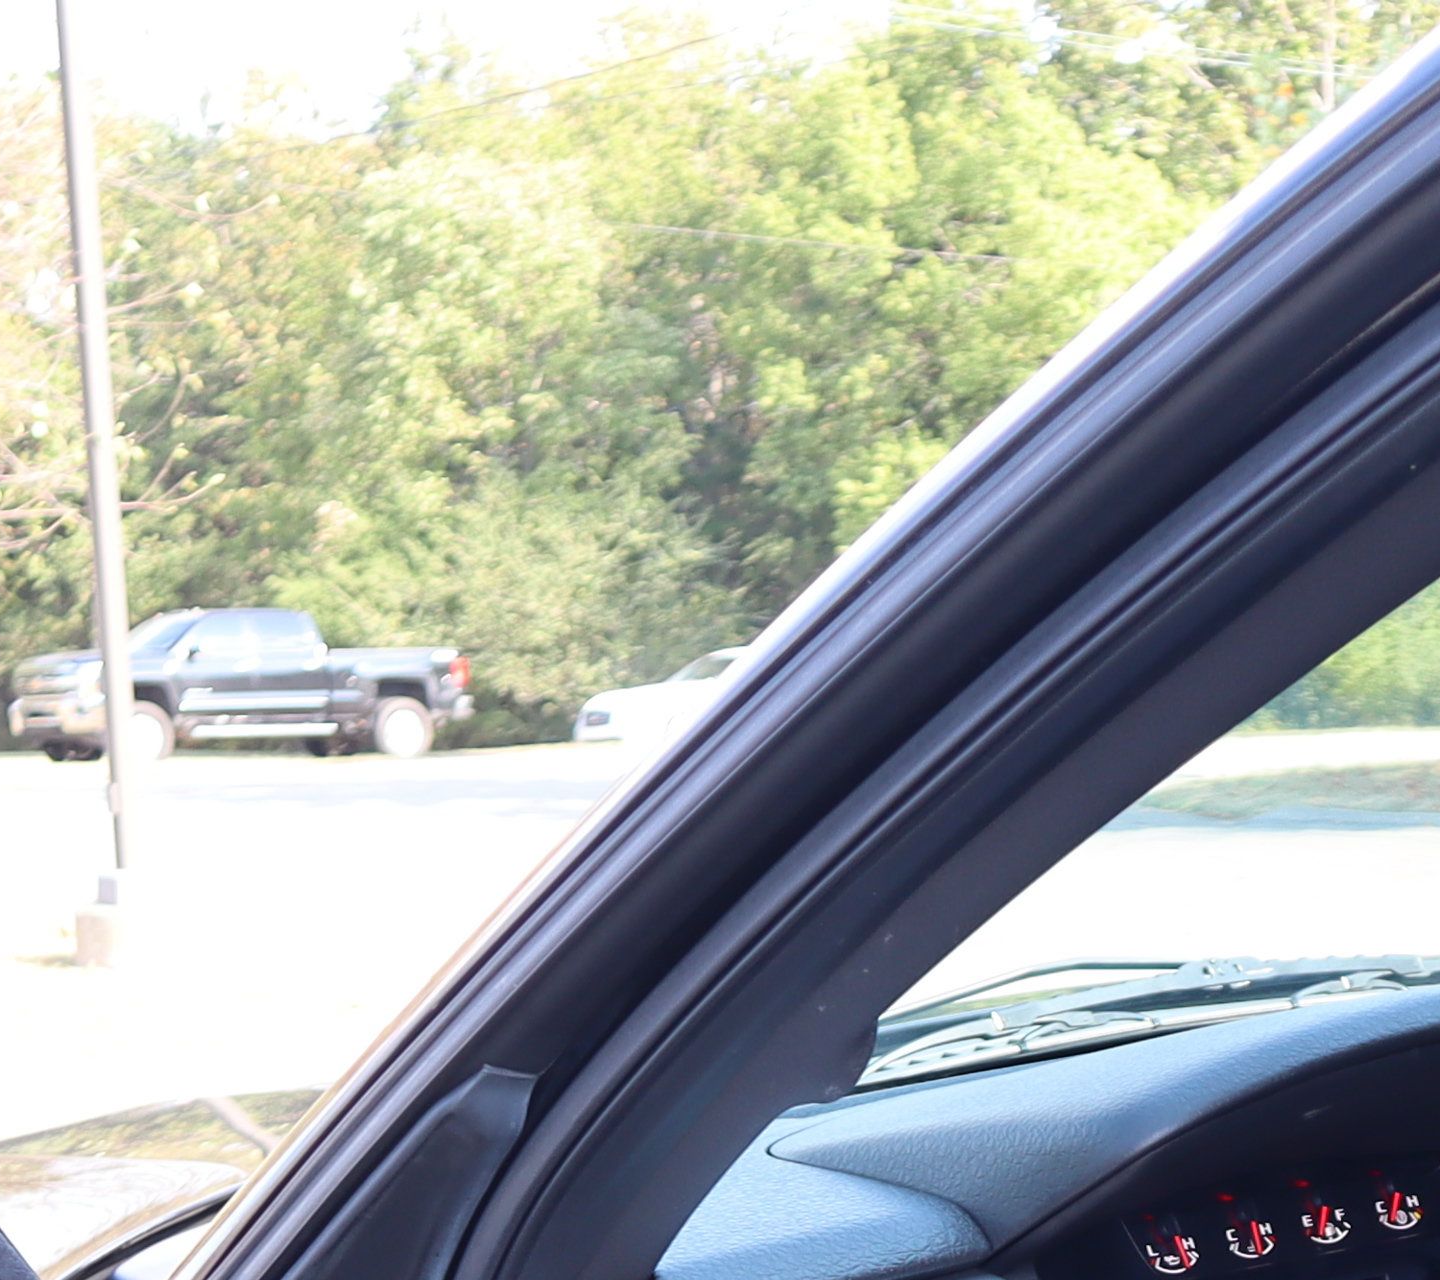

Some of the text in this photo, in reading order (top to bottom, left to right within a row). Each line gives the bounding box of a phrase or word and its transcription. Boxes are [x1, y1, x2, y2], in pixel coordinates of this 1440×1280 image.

[1375, 1195, 1420, 1214] C H
[1301, 1208, 1346, 1228] E F
[1225, 1222, 1273, 1243] C H
[1145, 1236, 1196, 1258] L H
